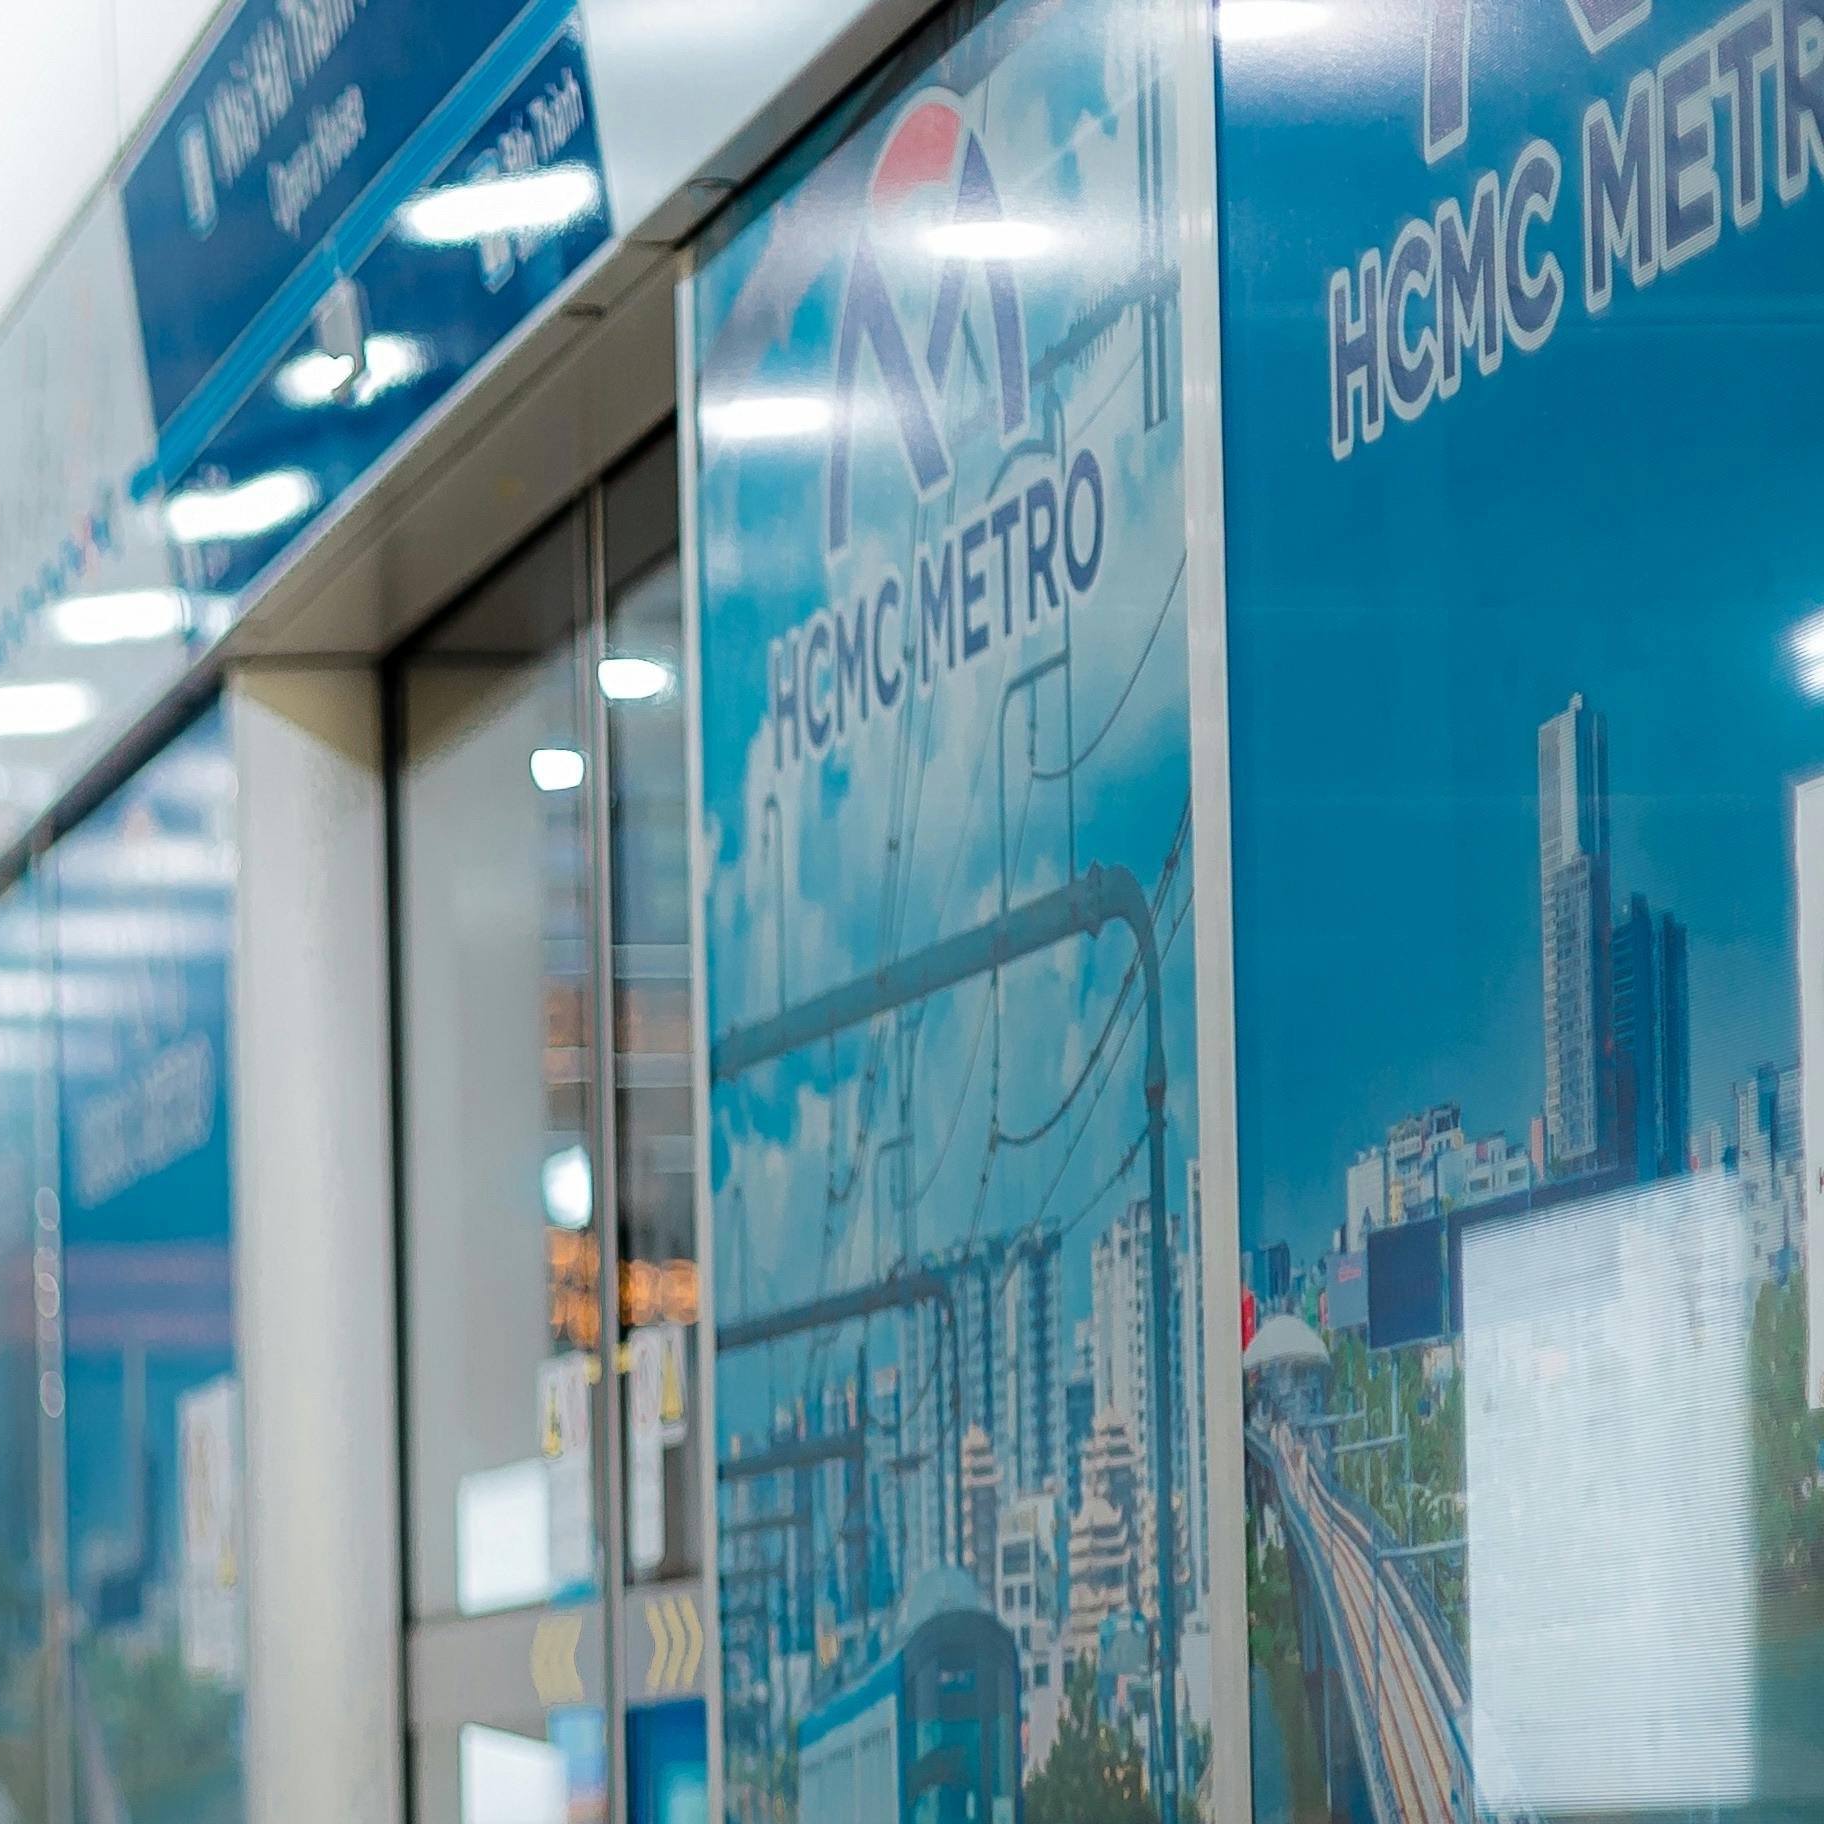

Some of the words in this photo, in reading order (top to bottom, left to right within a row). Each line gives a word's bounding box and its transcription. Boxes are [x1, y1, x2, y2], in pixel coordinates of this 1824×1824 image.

[1330, 138, 1565, 461] HCMC
[769, 576, 901, 773] HCMC
[919, 448, 1105, 686] METRO
